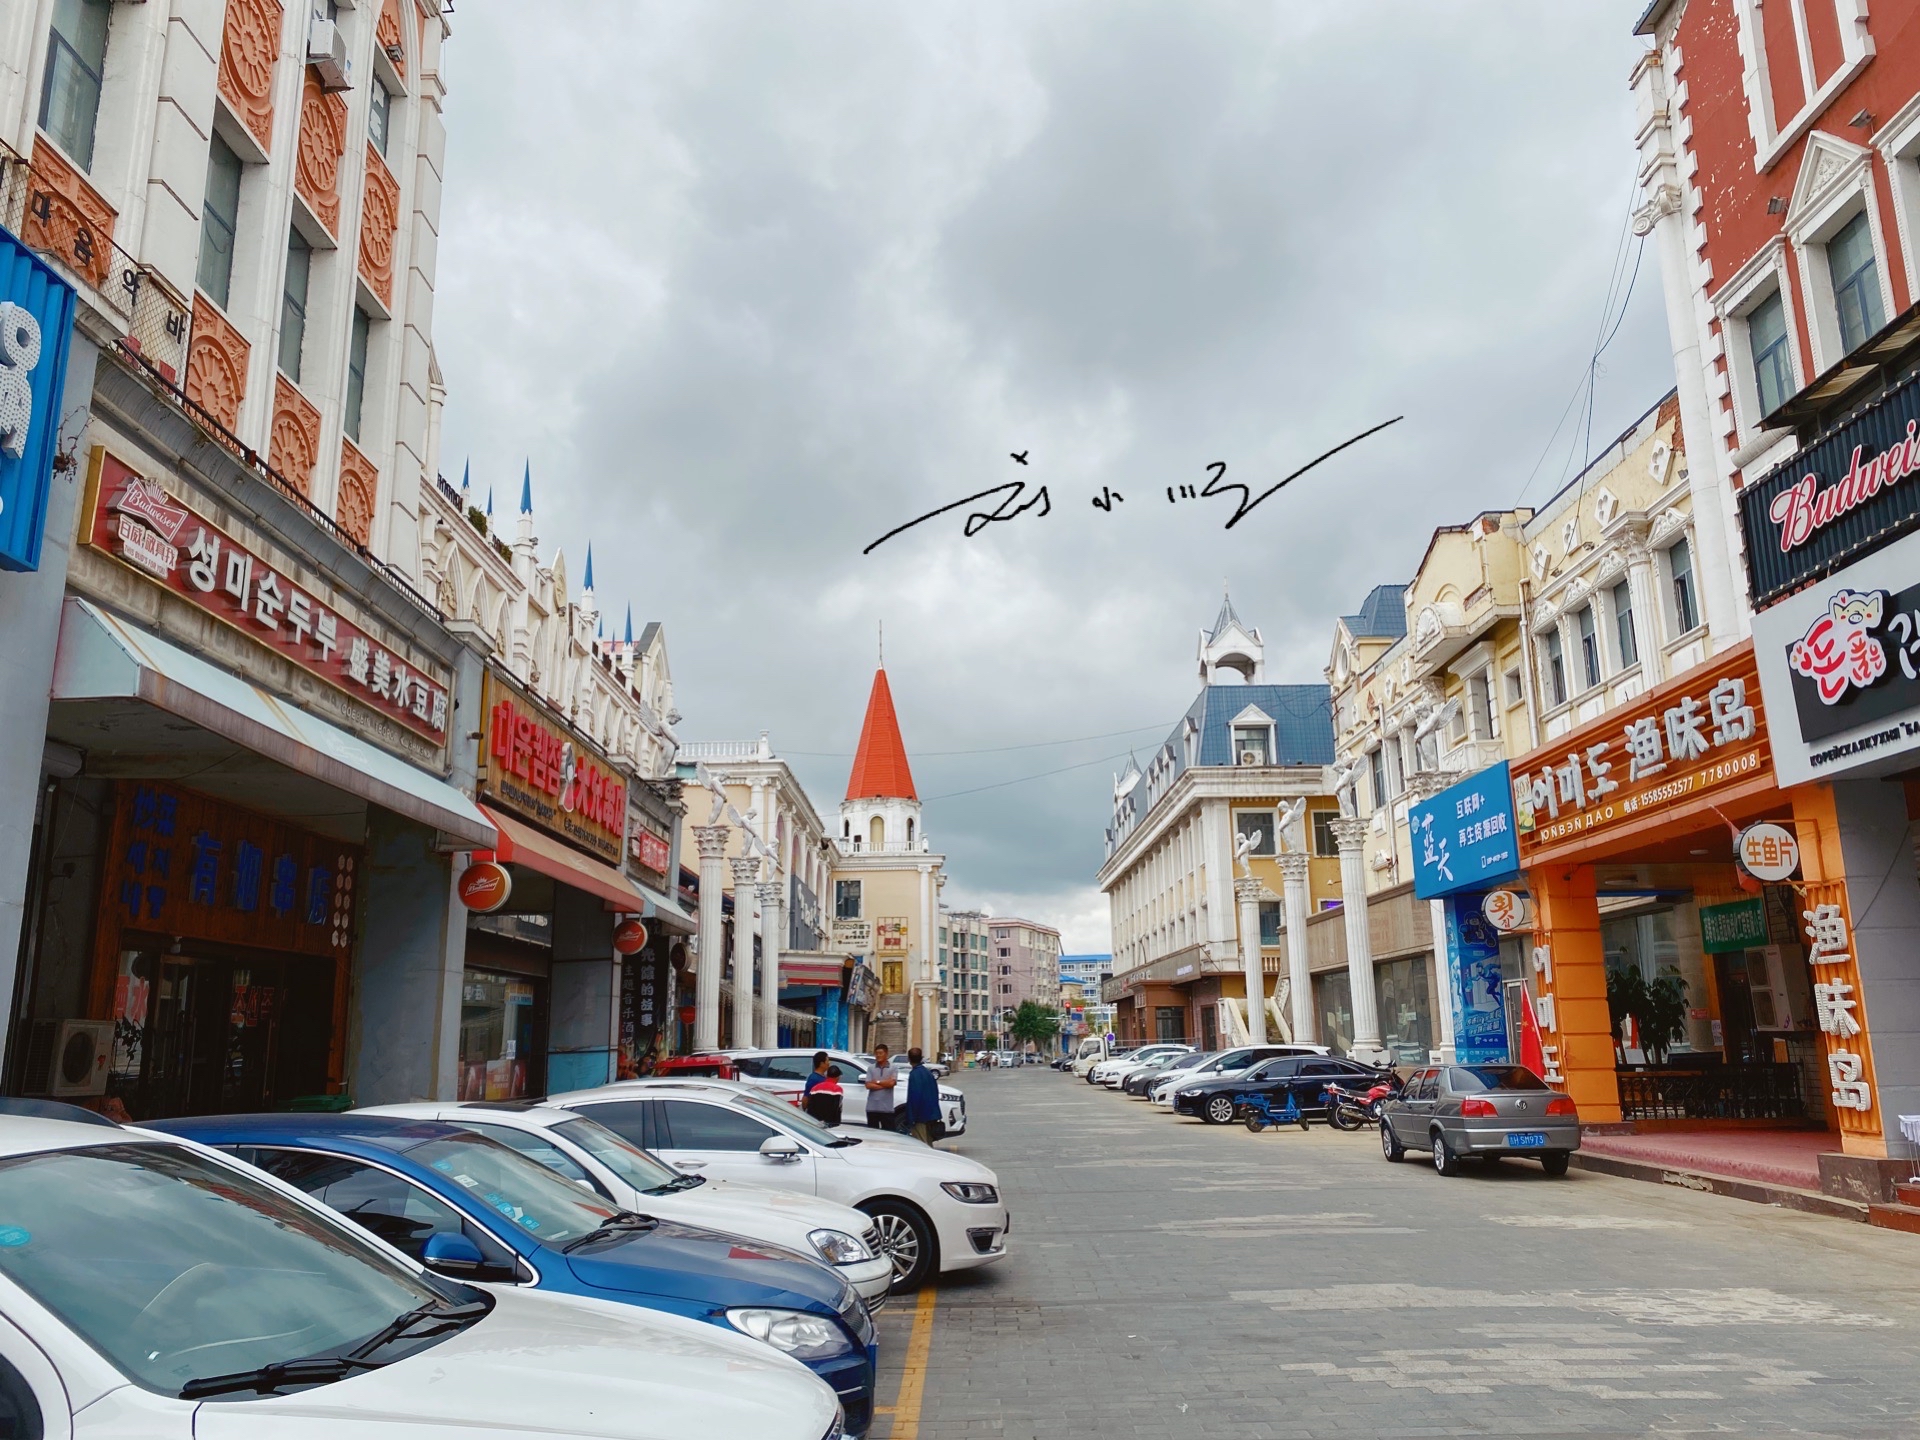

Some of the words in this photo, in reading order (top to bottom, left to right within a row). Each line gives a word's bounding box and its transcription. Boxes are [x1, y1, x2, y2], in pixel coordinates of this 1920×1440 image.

[127, 484, 177, 530] Budweiser
[187, 526, 338, 662] 성미순두부
[349, 637, 447, 734] 盛美水豆腐
[1623, 678, 1757, 784] 渔味岛
[1701, 753, 1757, 785] 7780008
[1456, 792, 1485, 819] 互联网+
[1530, 743, 1619, 820] 어미도
[1459, 812, 1508, 848] 再生资源回收
[1746, 835, 1794, 868] 生鱼片
[1532, 944, 1565, 1084] 어미도
[1802, 904, 1872, 1112] 渔味岛
